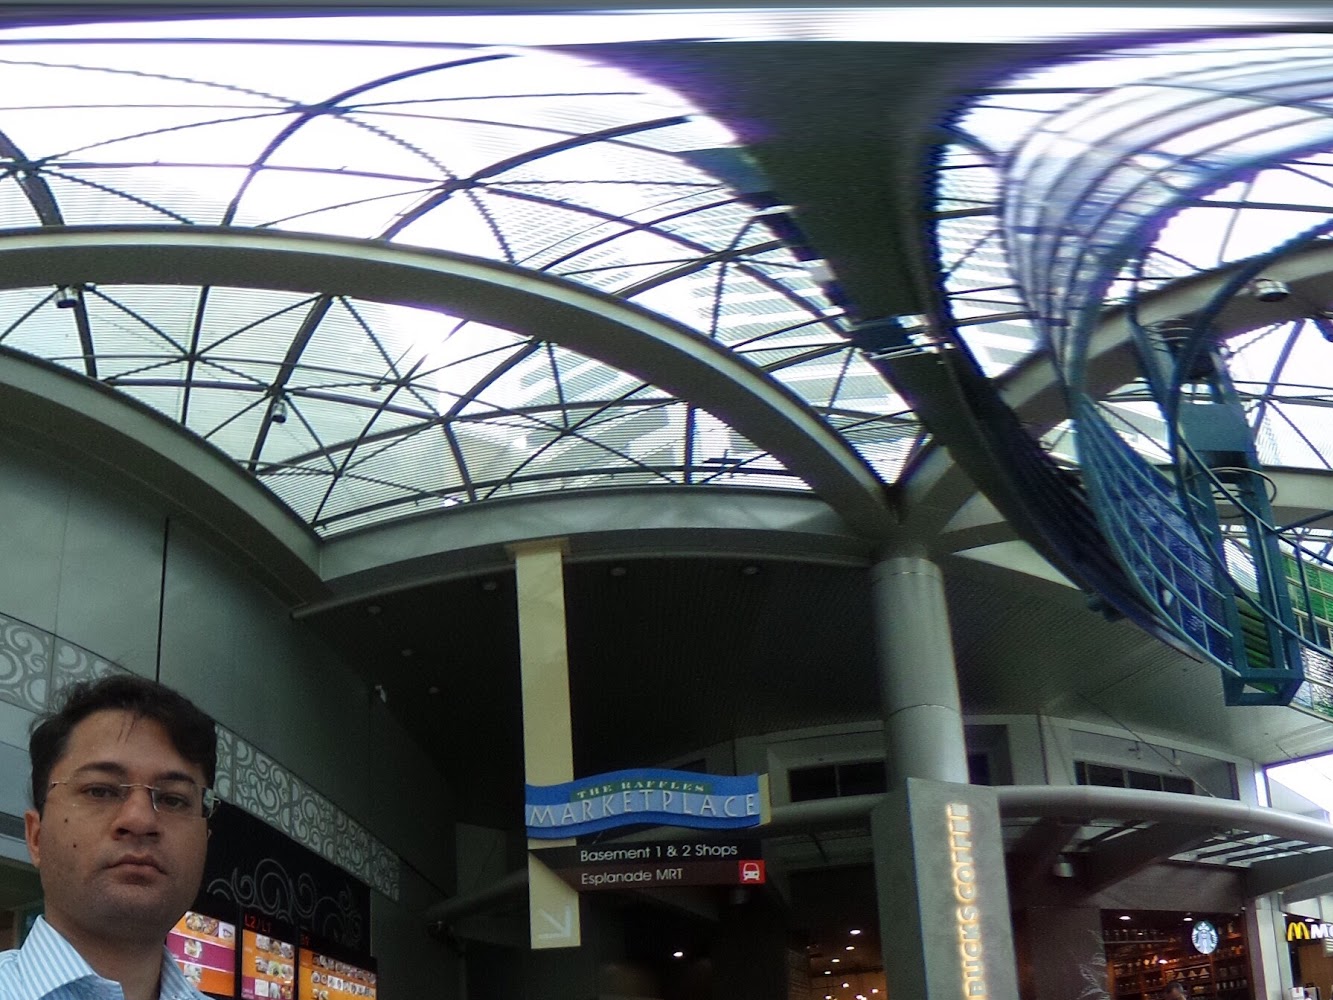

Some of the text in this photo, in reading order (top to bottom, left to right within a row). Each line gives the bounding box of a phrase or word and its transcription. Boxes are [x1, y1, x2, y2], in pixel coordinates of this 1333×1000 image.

[577, 780, 705, 799] THE RAFFLES
[529, 789, 760, 827] MARKETPLACE
[580, 843, 738, 862] Basement 1 & 2 Shops
[947, 802, 976, 904] COFFEE
[581, 868, 683, 885] Esplanade MRT
